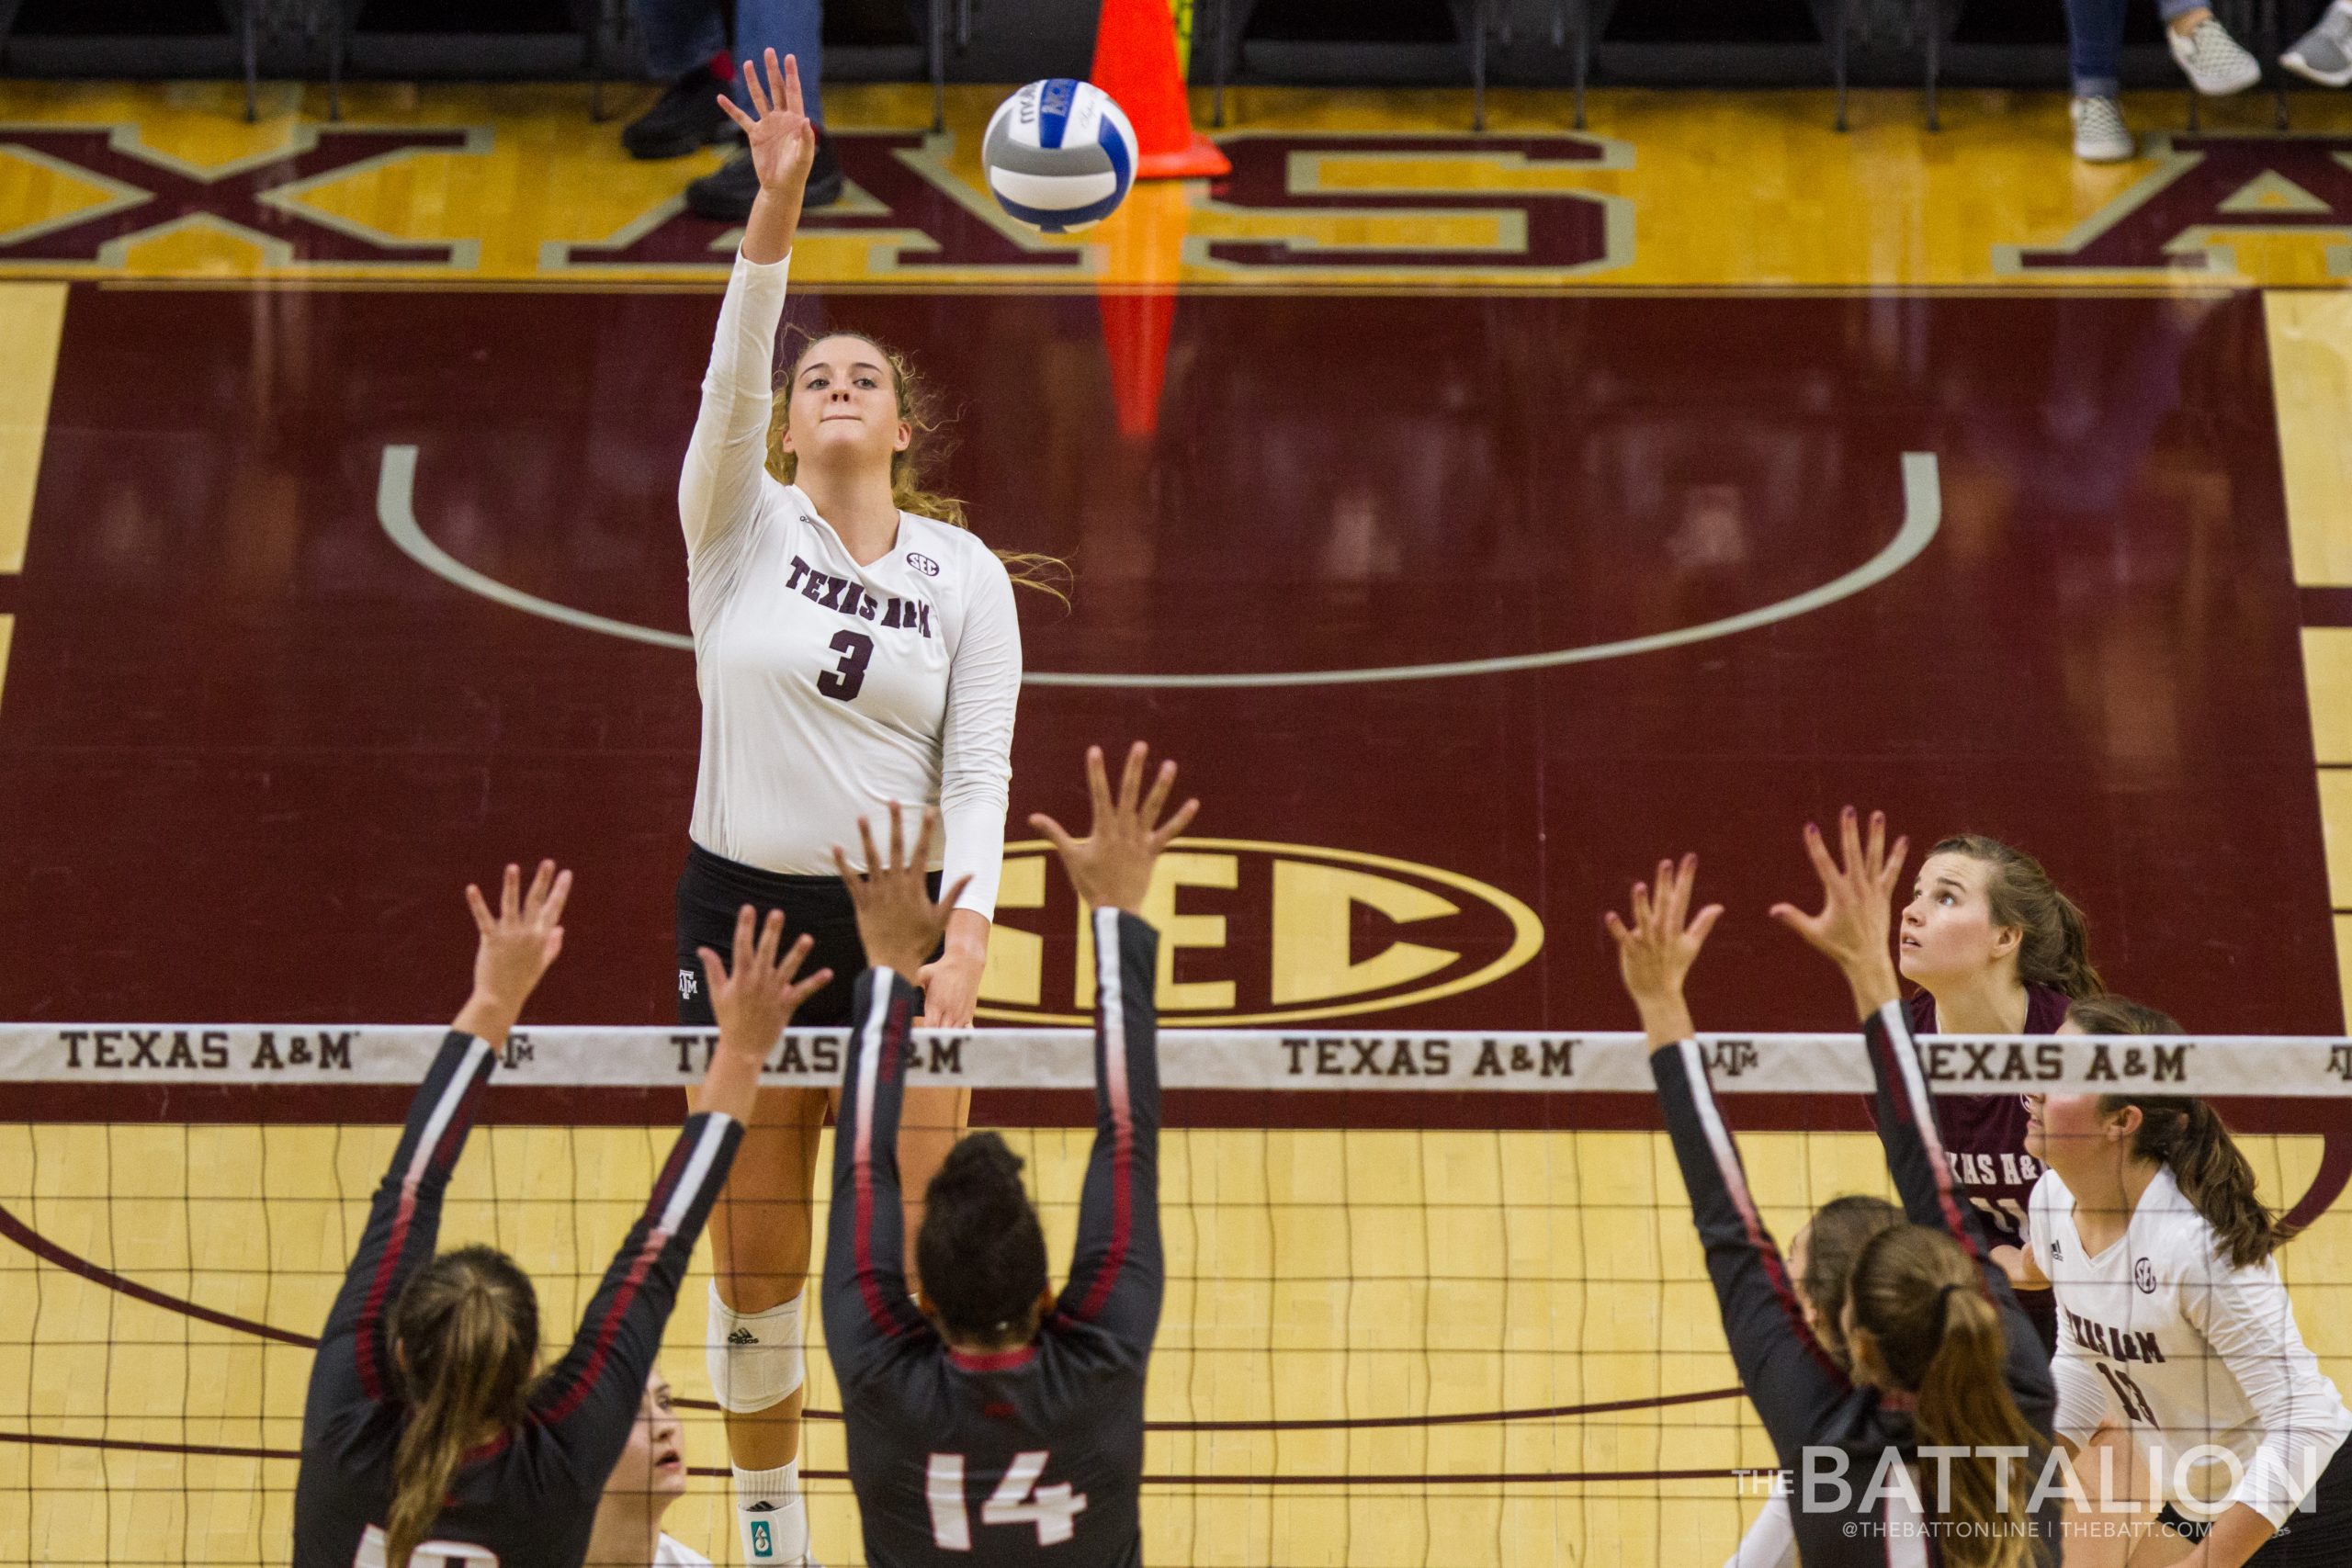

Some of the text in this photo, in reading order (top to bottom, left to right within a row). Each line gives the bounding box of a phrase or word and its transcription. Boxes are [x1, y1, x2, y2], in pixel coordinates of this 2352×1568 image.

[908, 553, 939, 577] SEC
[786, 555, 932, 638] TEXAS A&M
[817, 629, 875, 702] 3
[60, 1031, 353, 1069] TEXAS A&M
[671, 1035, 840, 1074] TAS
[1282, 1038, 1575, 1077] TEXAS A&M
[1917, 1043, 2188, 1081] EXAS A&M
[2000, 1153, 2048, 1185] A&
[925, 1450, 1089, 1551] 14
